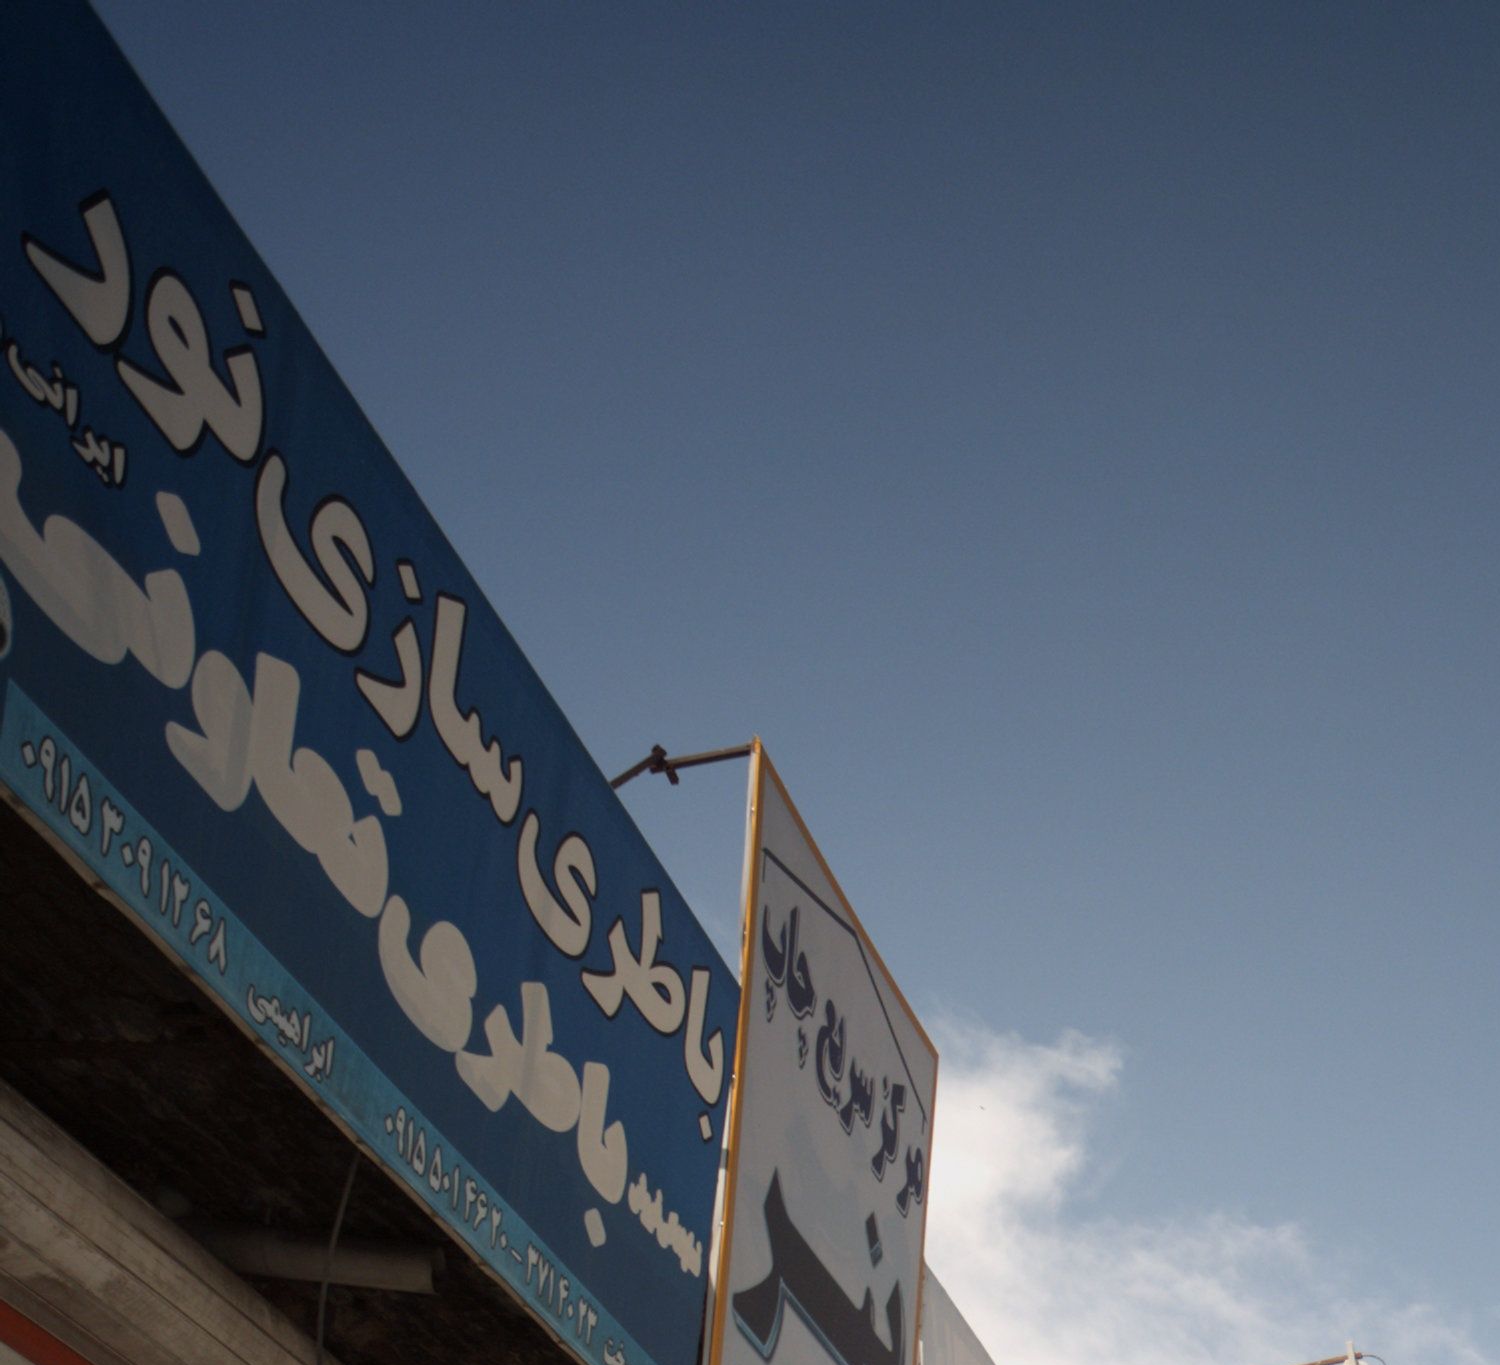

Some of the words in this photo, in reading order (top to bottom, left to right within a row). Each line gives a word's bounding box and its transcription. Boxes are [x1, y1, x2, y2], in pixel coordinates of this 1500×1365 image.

[20, 189, 266, 462] نور
[255, 449, 522, 825] سازی
[517, 809, 725, 1143] باطری
[762, 904, 816, 1072] چاپ
[816, 1000, 874, 1135] سریع
[871, 1079, 925, 1218] مرکز
